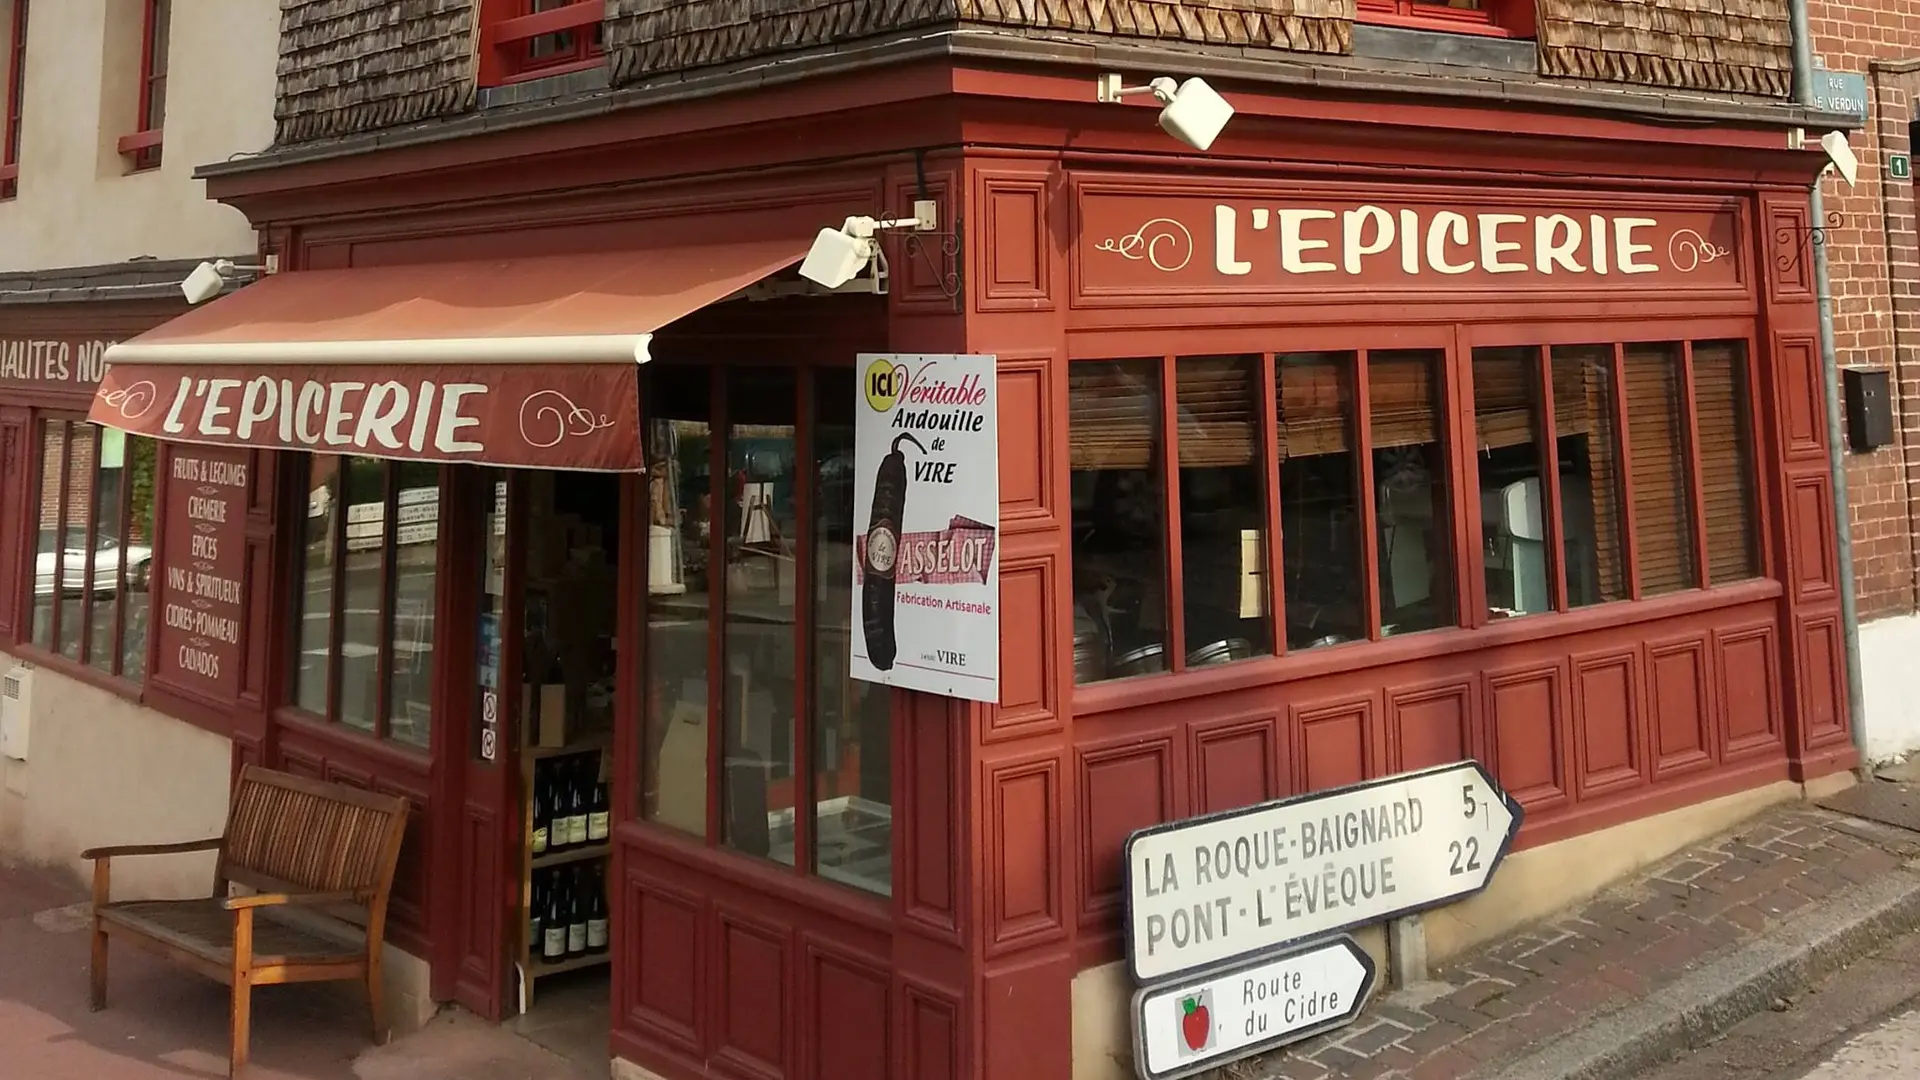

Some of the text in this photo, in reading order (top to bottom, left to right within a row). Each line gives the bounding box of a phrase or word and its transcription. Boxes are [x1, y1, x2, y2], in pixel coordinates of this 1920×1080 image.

[1828, 78, 1844, 90] RUE
[1828, 97, 1864, 112] VERDUN
[1895, 158, 1903, 175] 1
[1214, 204, 1660, 276] L'EPICERIE
[0, 339, 69, 380] IALITES
[871, 361, 987, 406] ICI Véritable
[163, 375, 488, 452] L'EPICERIE
[892, 407, 984, 432] Andouille
[931, 437, 946, 452] de
[173, 457, 247, 488] FRUITS & LEGUMES
[915, 461, 957, 484] VIRE
[187, 495, 227, 523] CREMERIE
[191, 534, 218, 560] EPICES
[900, 537, 987, 575] ASSELOT
[168, 566, 241, 605] VINS & SPIRITUEUX
[896, 591, 992, 615] Fabrication Artisanale
[179, 645, 219, 679] CALVADOS
[936, 649, 967, 667] VIRE
[1144, 784, 1477, 898] LA ROQUE-BAIGNARD 5
[1448, 836, 1482, 877] 22
[1243, 971, 1302, 1006] Route
[1245, 990, 1338, 1037] du Cidre
